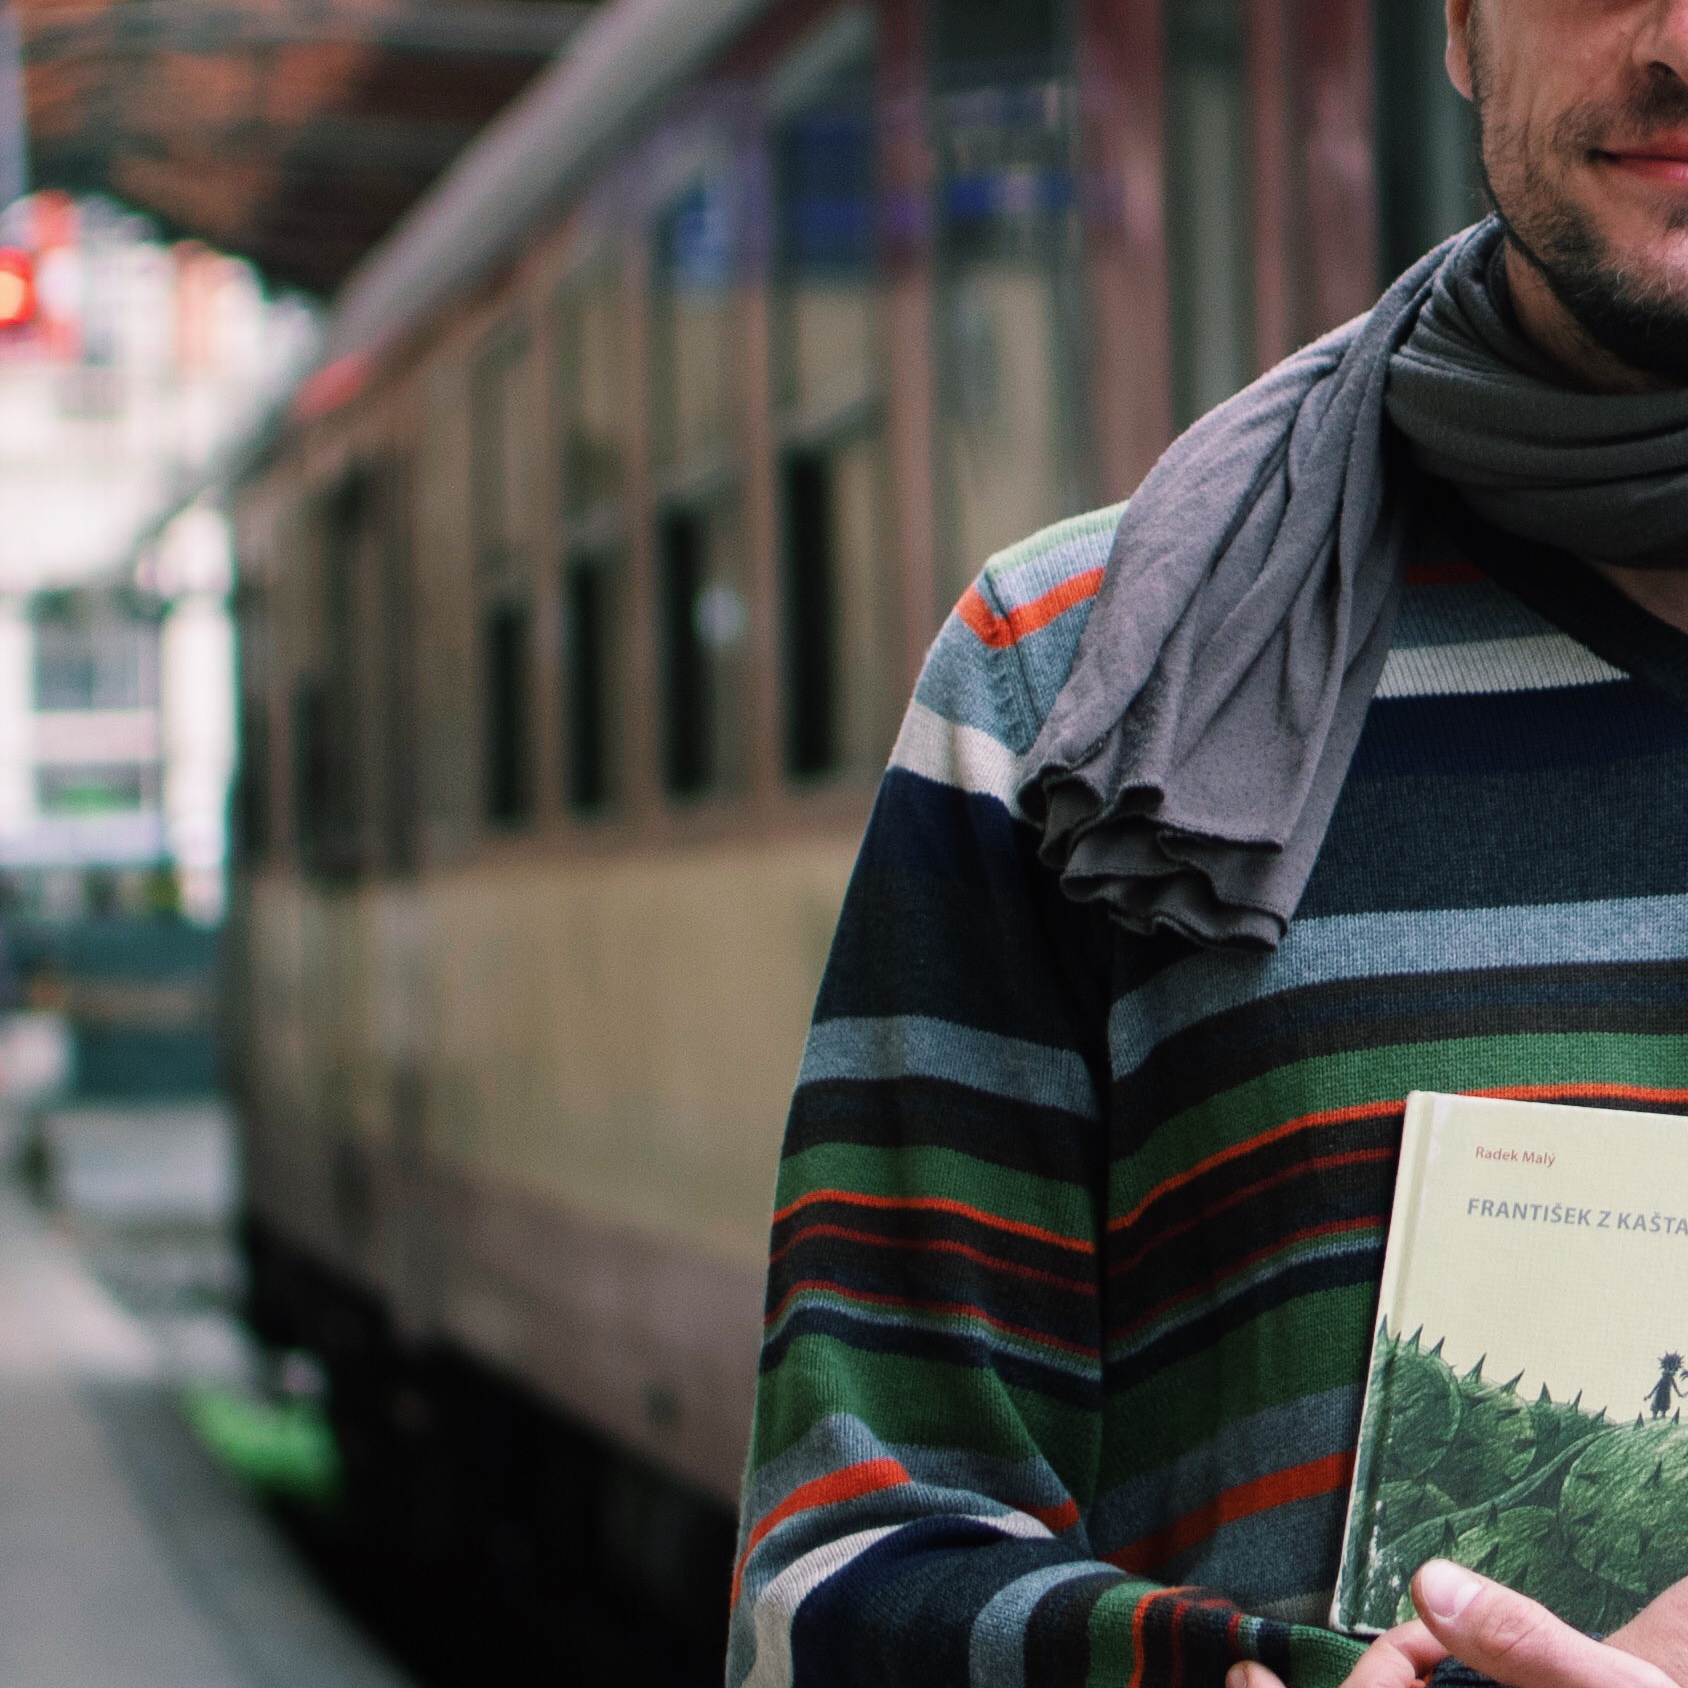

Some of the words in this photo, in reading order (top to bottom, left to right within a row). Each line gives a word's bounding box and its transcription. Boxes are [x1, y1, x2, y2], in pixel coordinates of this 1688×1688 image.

[1475, 1146, 1519, 1162] Radek
[1522, 1150, 1557, 1168] Malý
[1467, 1198, 1593, 1226] FRANTIŠEK
[1596, 1210, 1612, 1229] Z
